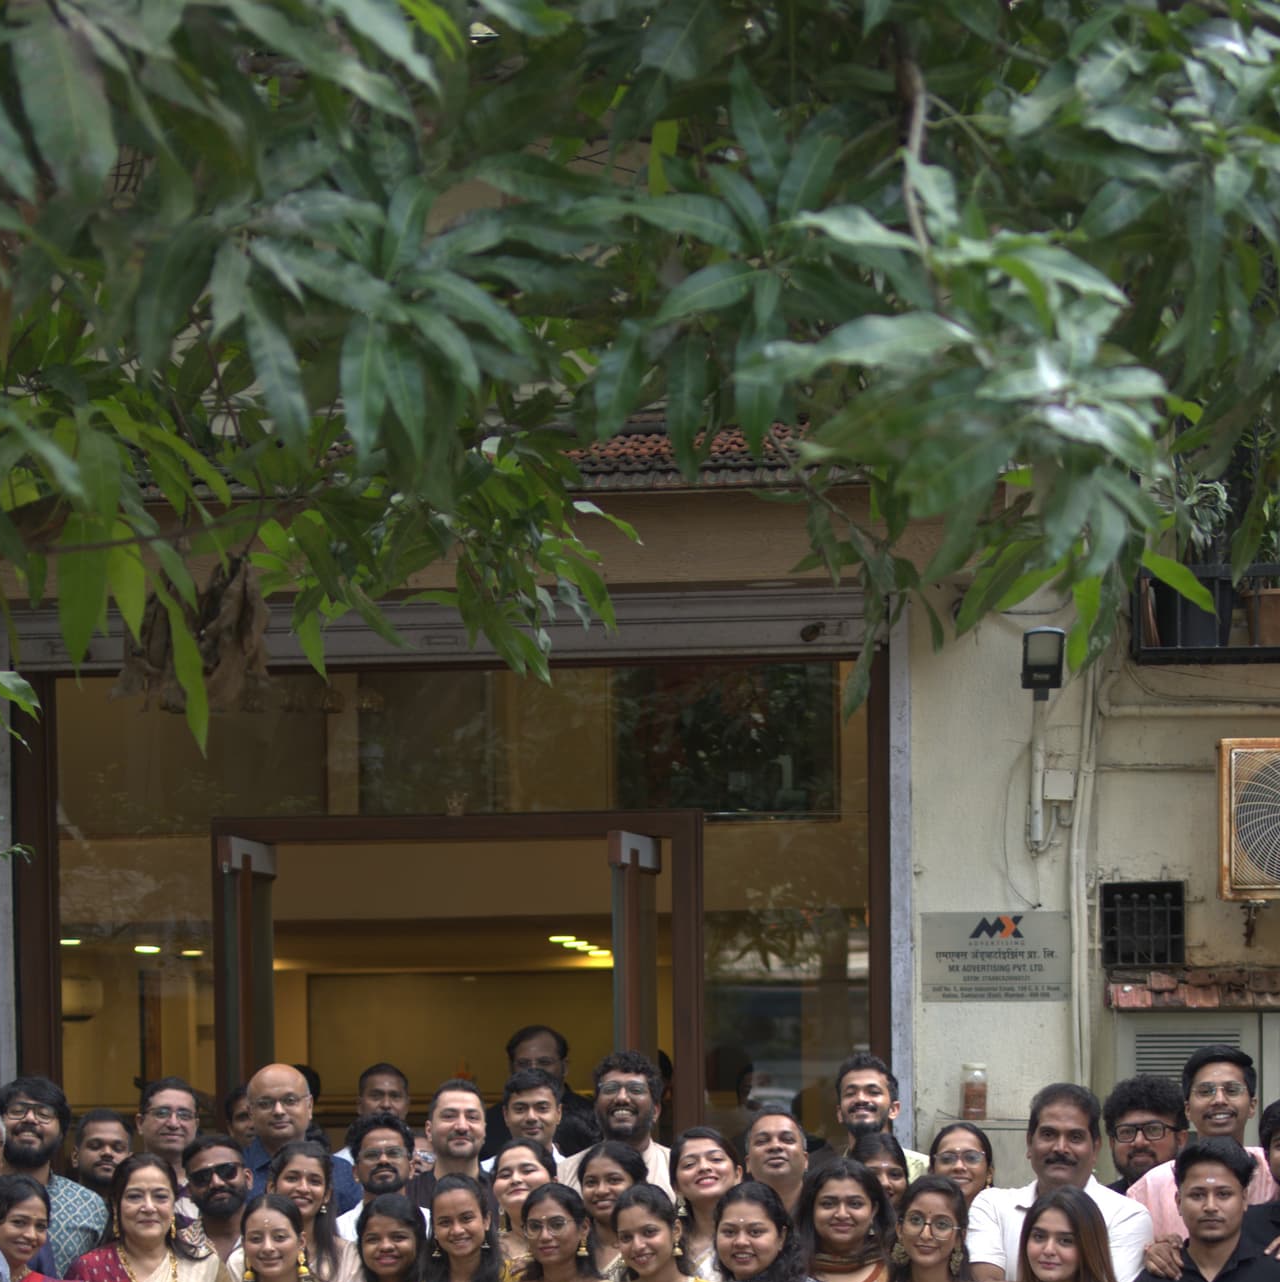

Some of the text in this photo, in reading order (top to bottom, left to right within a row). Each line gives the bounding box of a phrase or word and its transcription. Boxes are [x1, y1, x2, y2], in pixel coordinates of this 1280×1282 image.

[969, 915, 1024, 939] MX
[948, 964, 960, 973] MX
[961, 963, 1011, 973] ADVERTISING
